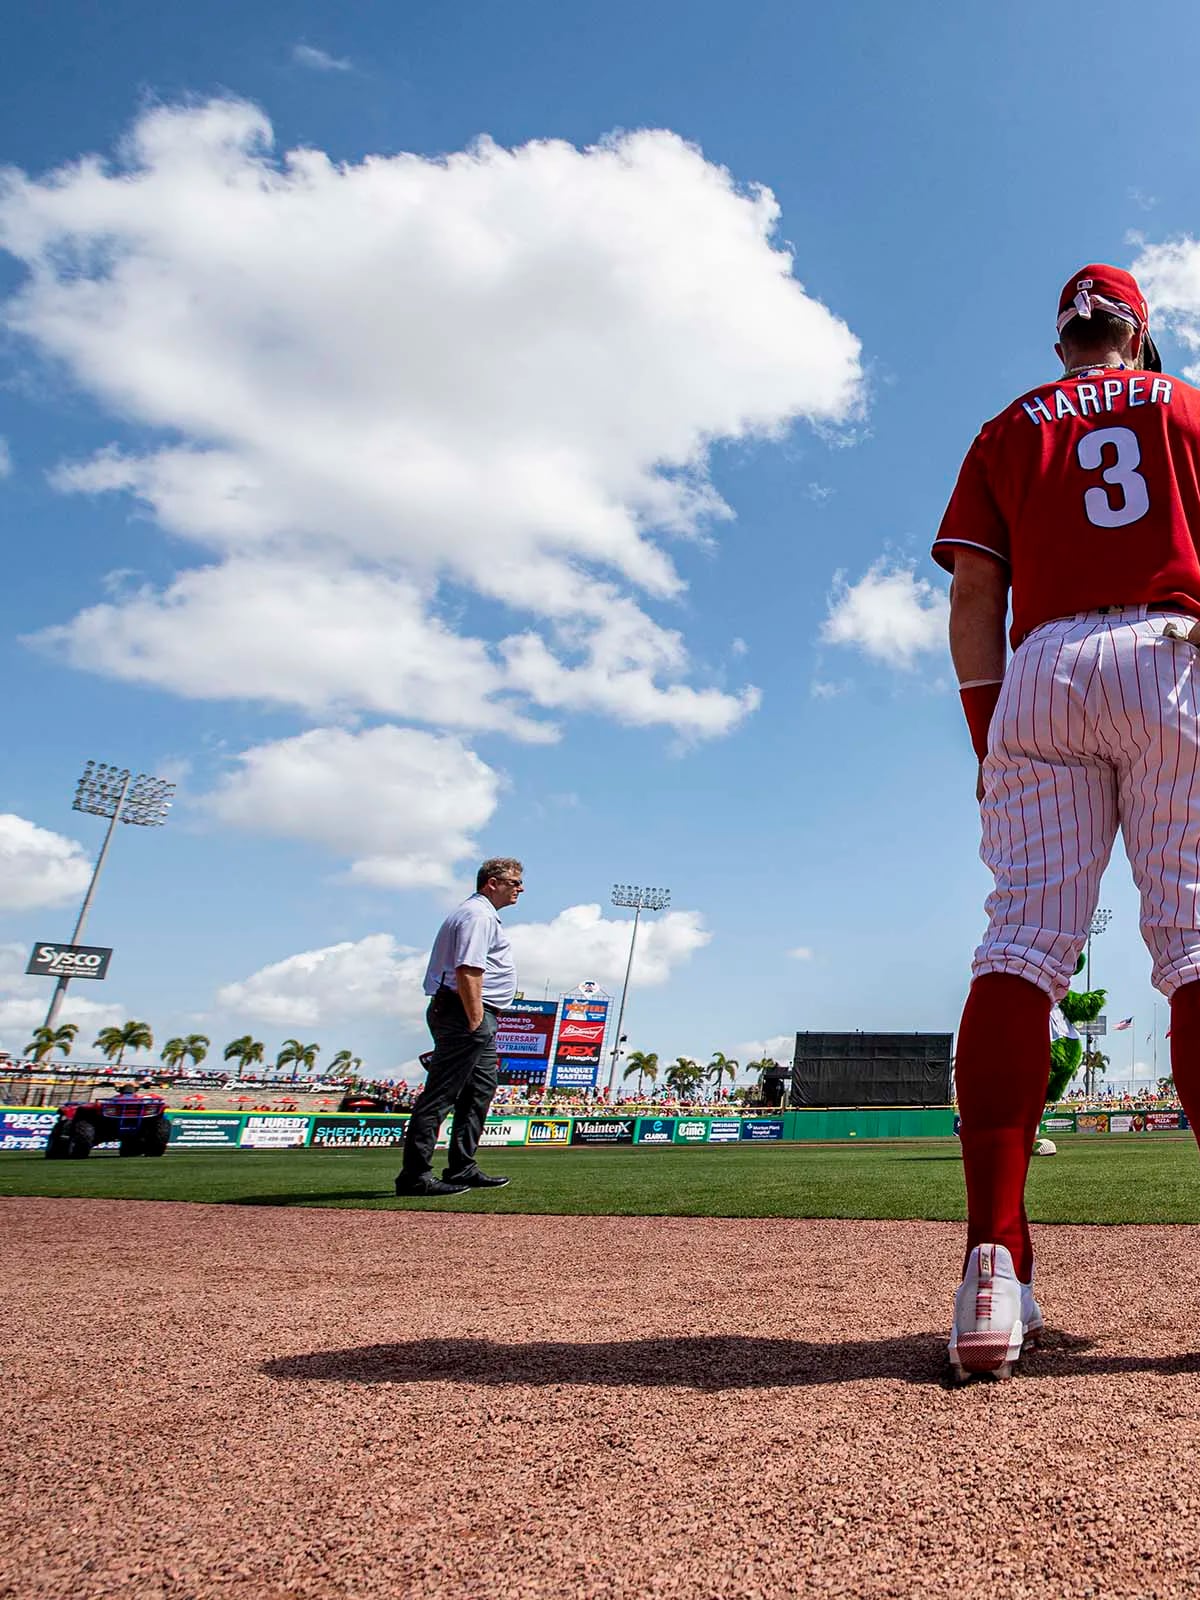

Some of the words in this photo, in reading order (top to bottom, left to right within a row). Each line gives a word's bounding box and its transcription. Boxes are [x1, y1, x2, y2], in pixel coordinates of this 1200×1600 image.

[1022, 377, 1173, 425] HARPER
[1077, 426, 1150, 528] 3
[36, 946, 102, 967] Sysco
[518, 1005, 544, 1013] Ballpark
[558, 1045, 596, 1056] DEX
[557, 1066, 594, 1074] BANQUET
[248, 1117, 308, 1128] INJURED?
[575, 1121, 632, 1136] MaintenX
[316, 1126, 402, 1137] SHEPHARD'S
[530, 1125, 552, 1139] CLEAR
[554, 1125, 568, 1138] SKY
